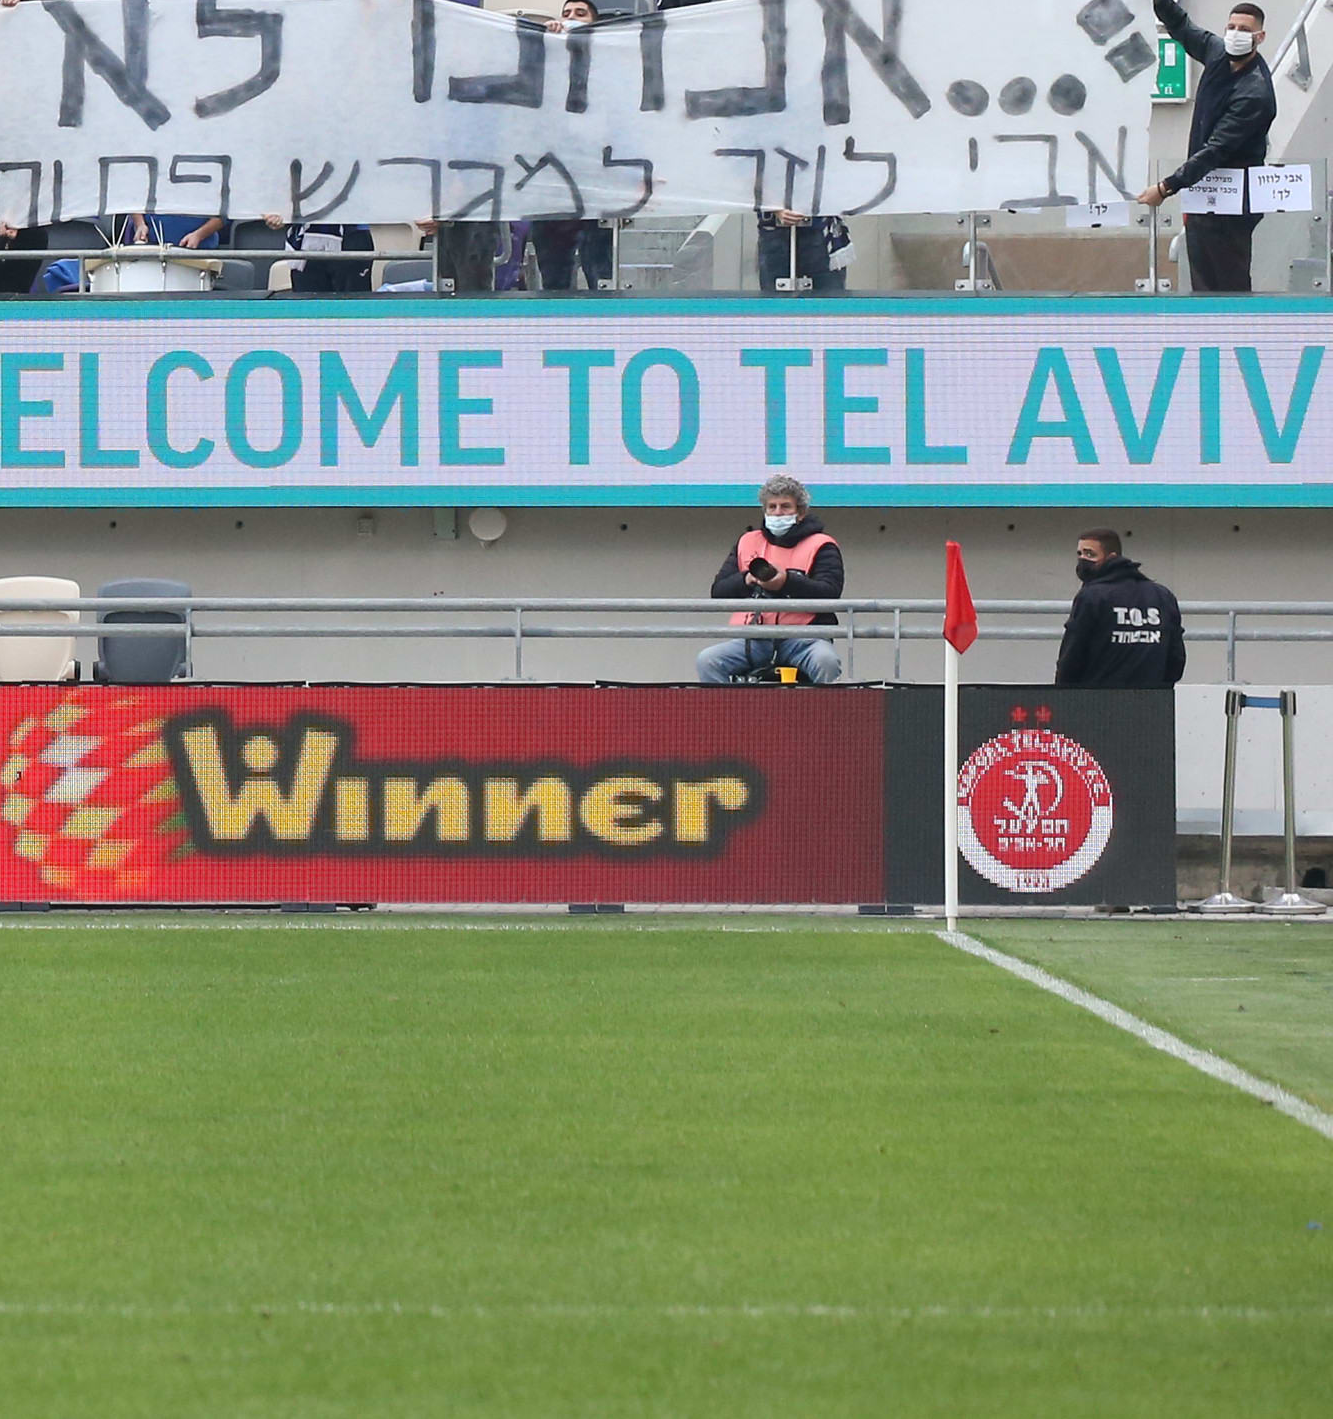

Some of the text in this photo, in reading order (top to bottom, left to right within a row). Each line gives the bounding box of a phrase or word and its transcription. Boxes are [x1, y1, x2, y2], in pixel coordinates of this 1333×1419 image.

[290, 146, 654, 223] למגרש
[714, 136, 898, 217] לוזר
[969, 125, 1140, 209] אבי
[1272, 187, 1291, 200] לך!
[1284, 173, 1304, 183] אבי
[542, 346, 701, 468] TO
[740, 346, 968, 467] TEL
[1006, 345, 1324, 466] AVIV
[179, 724, 749, 846] Winner
